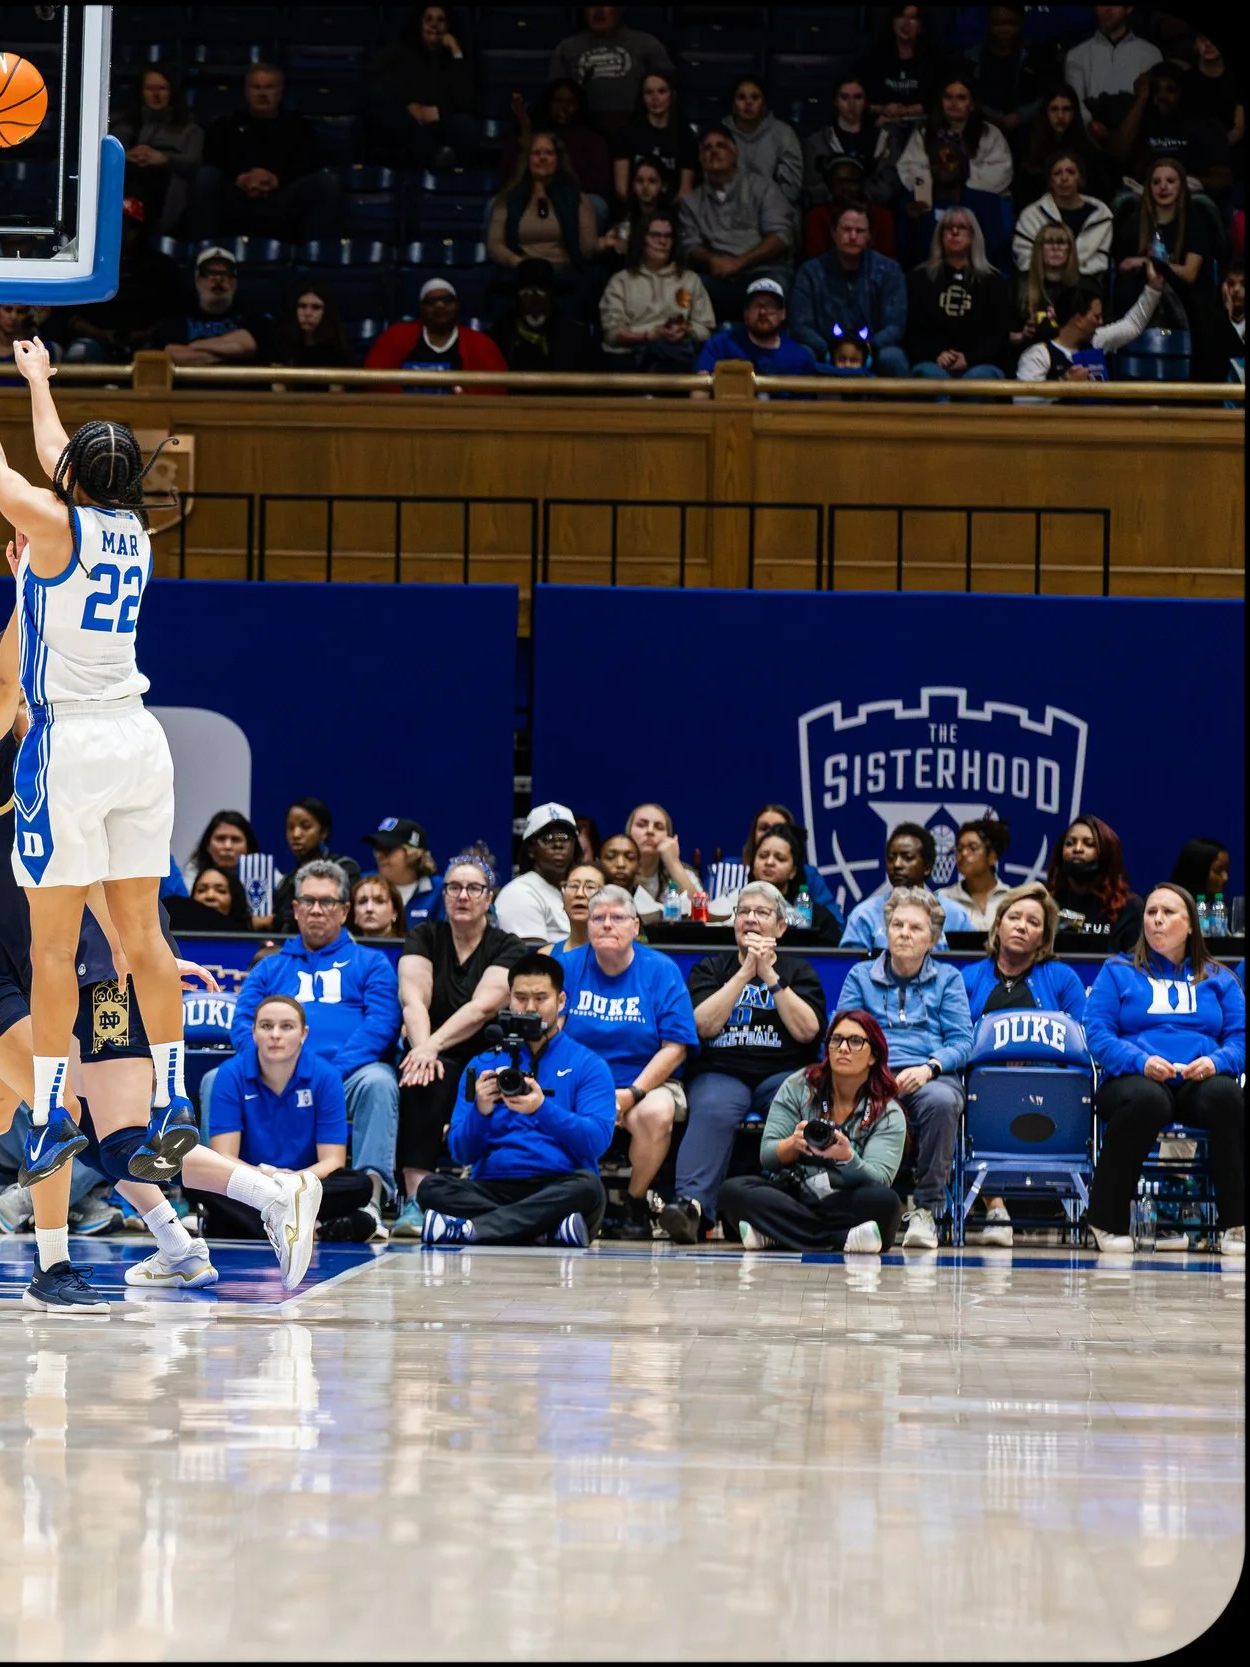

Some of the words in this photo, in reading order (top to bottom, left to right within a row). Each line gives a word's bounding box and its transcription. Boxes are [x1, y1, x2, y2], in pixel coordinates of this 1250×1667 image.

[102, 530, 139, 556] MAR
[81, 563, 143, 633] 22
[928, 723, 958, 743] THE
[823, 748, 1060, 814] SISTERHOOD
[23, 831, 45, 857] D
[577, 990, 641, 1017] DUKE
[993, 1015, 1066, 1054] DUKE
